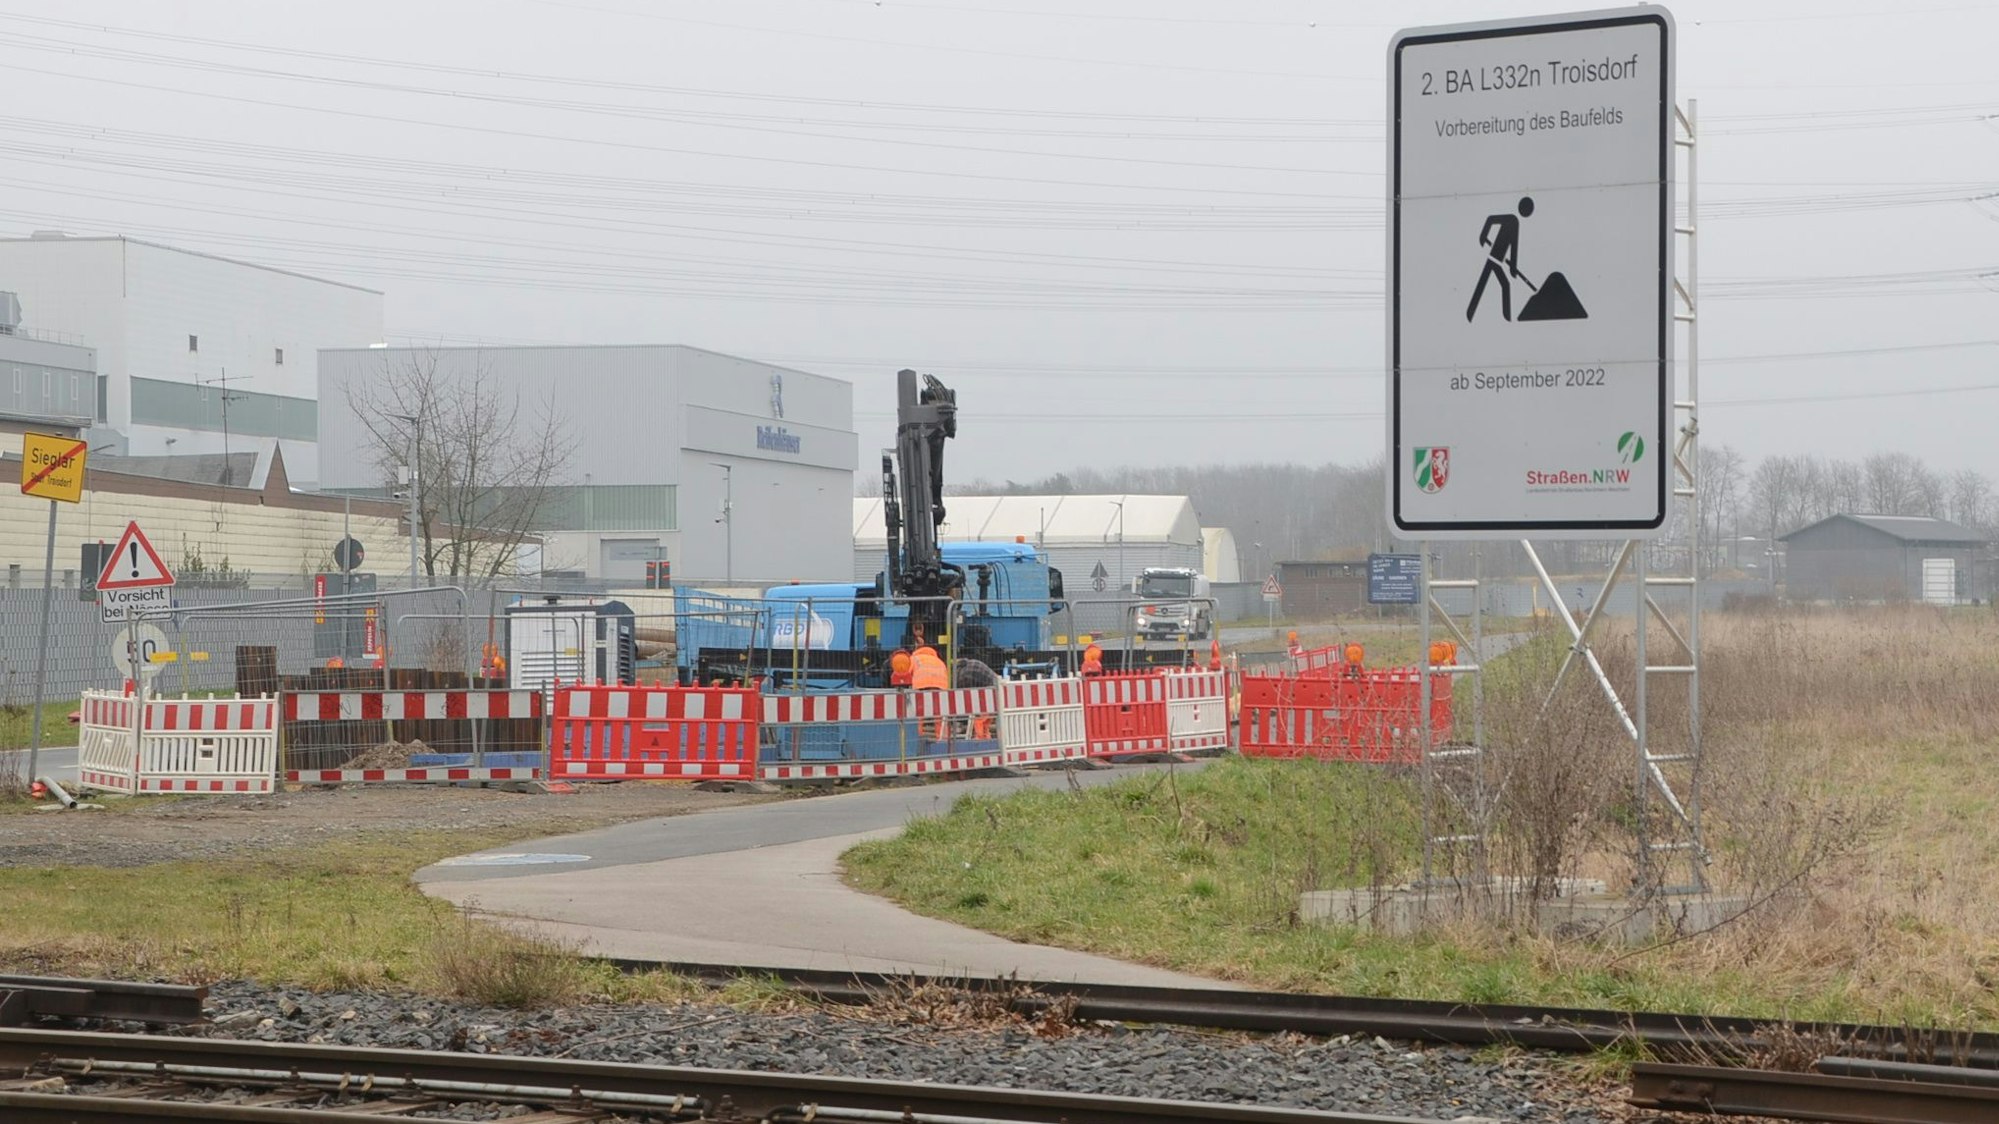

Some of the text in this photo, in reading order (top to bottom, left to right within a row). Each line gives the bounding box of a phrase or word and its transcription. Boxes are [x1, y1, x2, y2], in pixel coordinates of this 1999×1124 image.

[1421, 54, 1639, 95] 2. BA L332n Troisdorf
[1434, 107, 1624, 137] Vorbereitung des Baufelds
[1450, 368, 1605, 392] ab September 2022
[31, 448, 75, 470] Sieglar
[1526, 469, 1630, 485] Straßen.NRW
[107, 588, 165, 603] Vorsicht
[104, 606, 124, 618] bei
